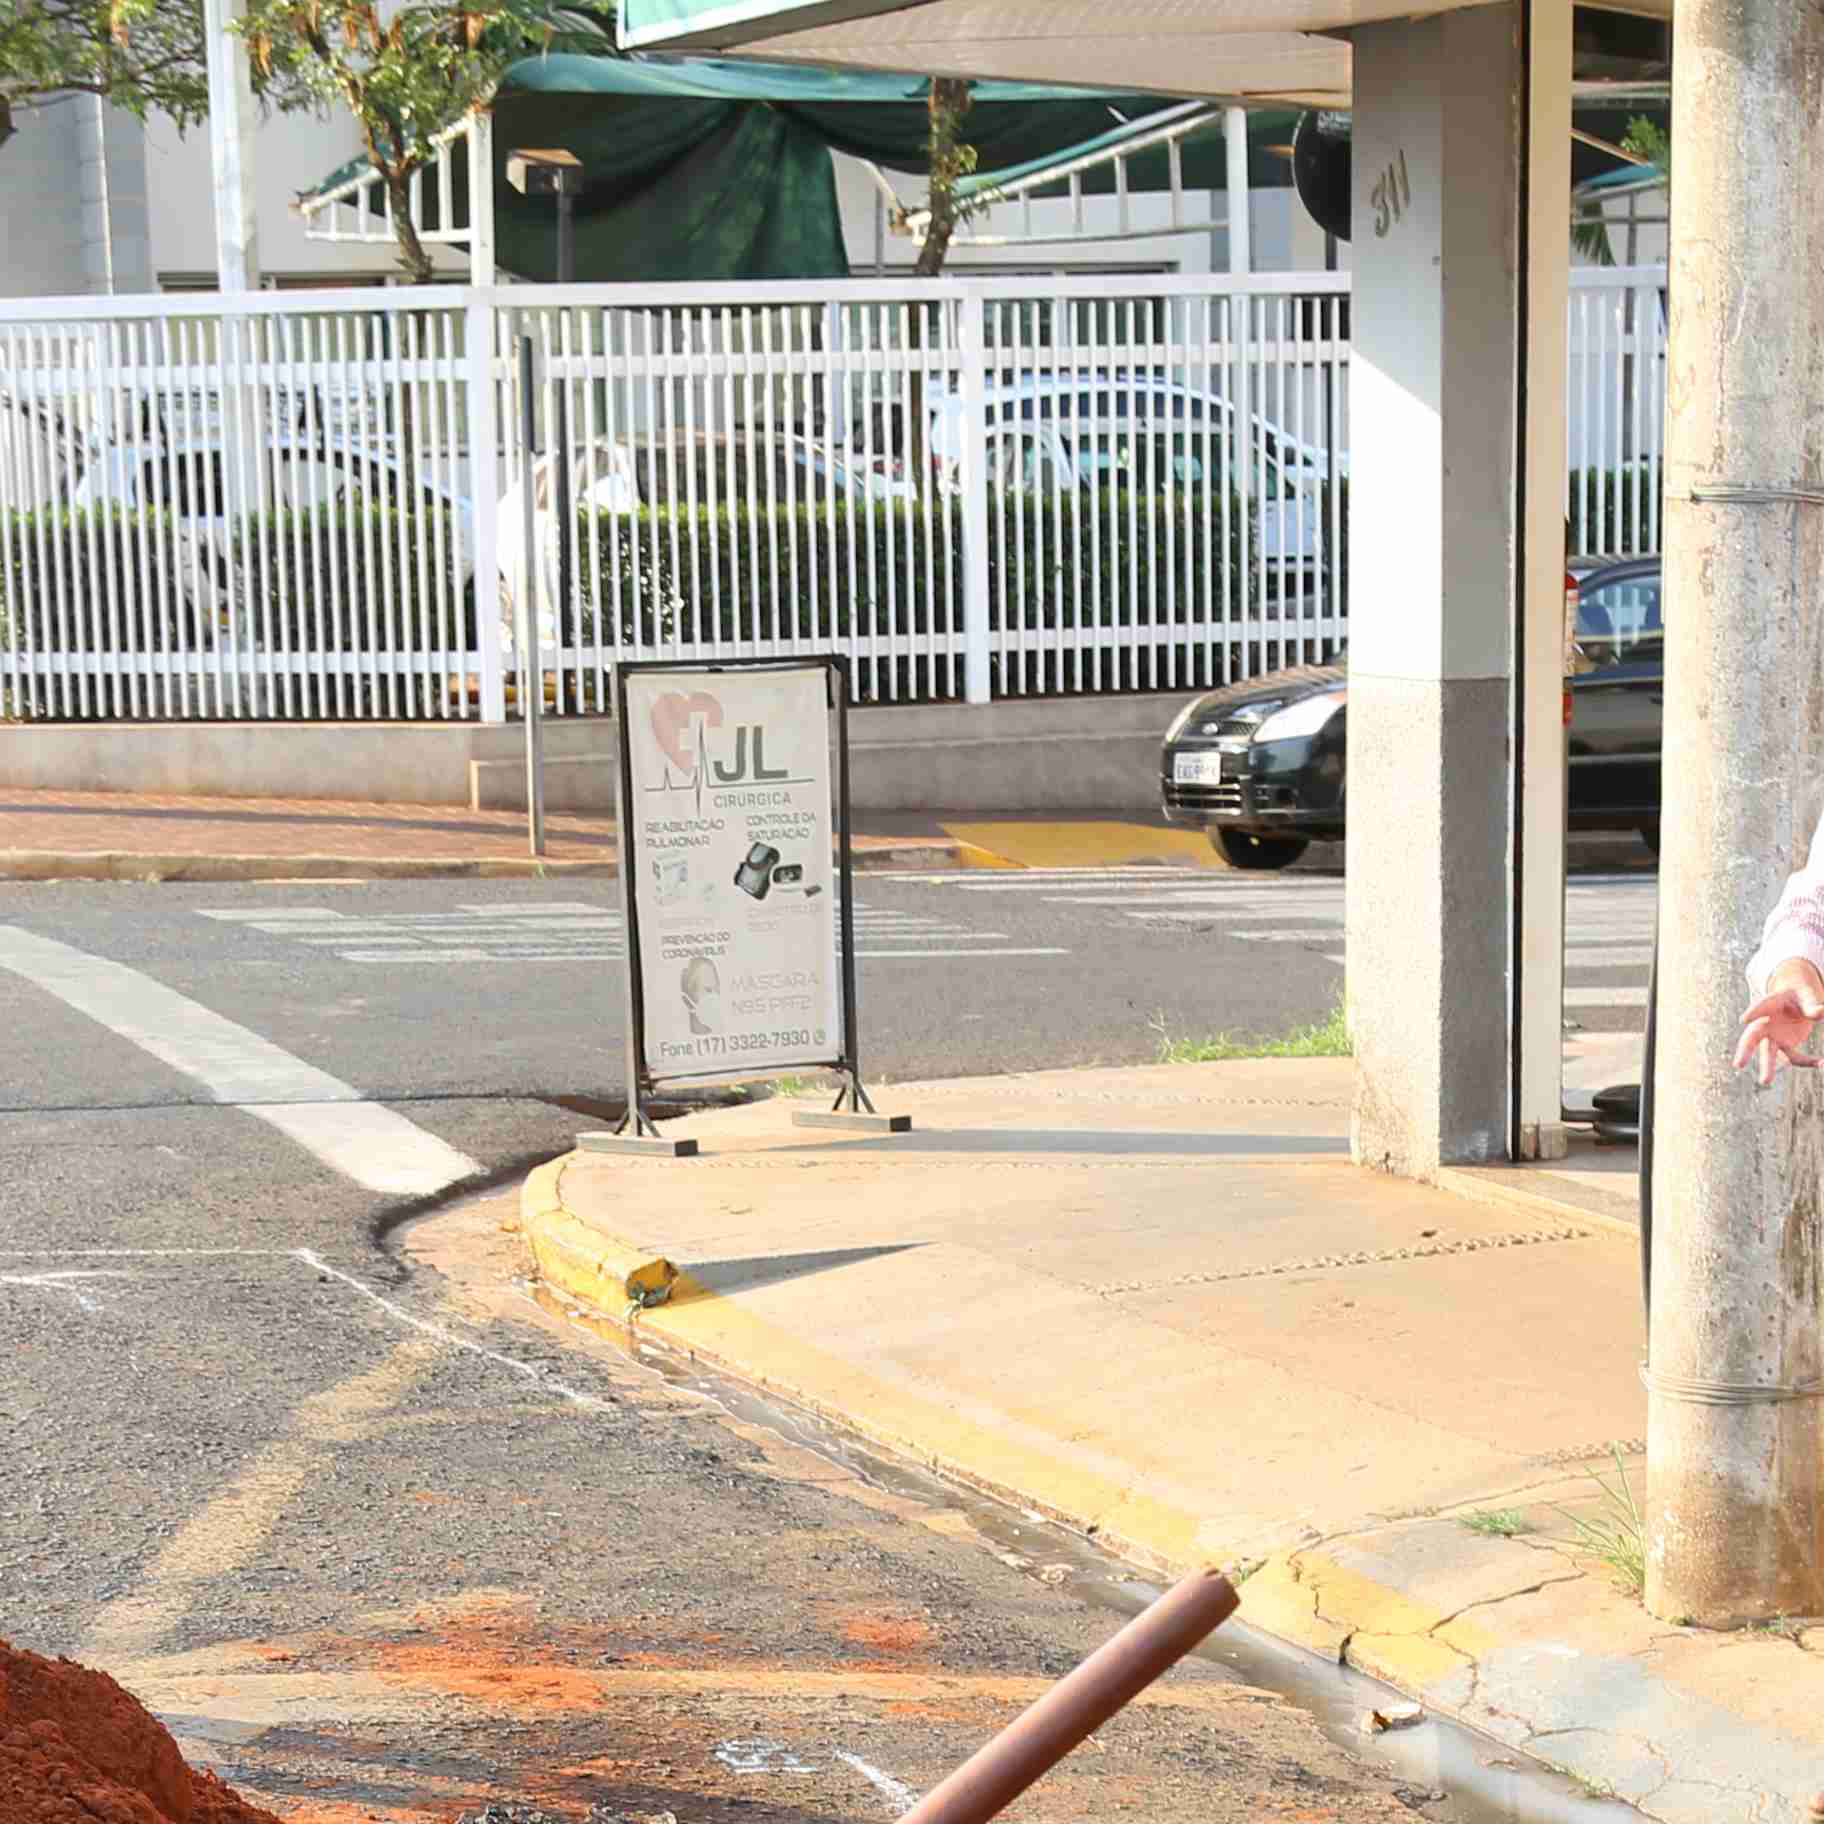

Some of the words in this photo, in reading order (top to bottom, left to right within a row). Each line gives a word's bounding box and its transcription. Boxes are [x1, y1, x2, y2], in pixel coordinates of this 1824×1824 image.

[1371, 149, 1410, 237] 311
[713, 726, 788, 781] JL
[801, 811, 816, 823] DA
[660, 1042, 693, 1056] Fone
[697, 1036, 726, 1056] (17)
[729, 1030, 810, 1051] 3322-7930
